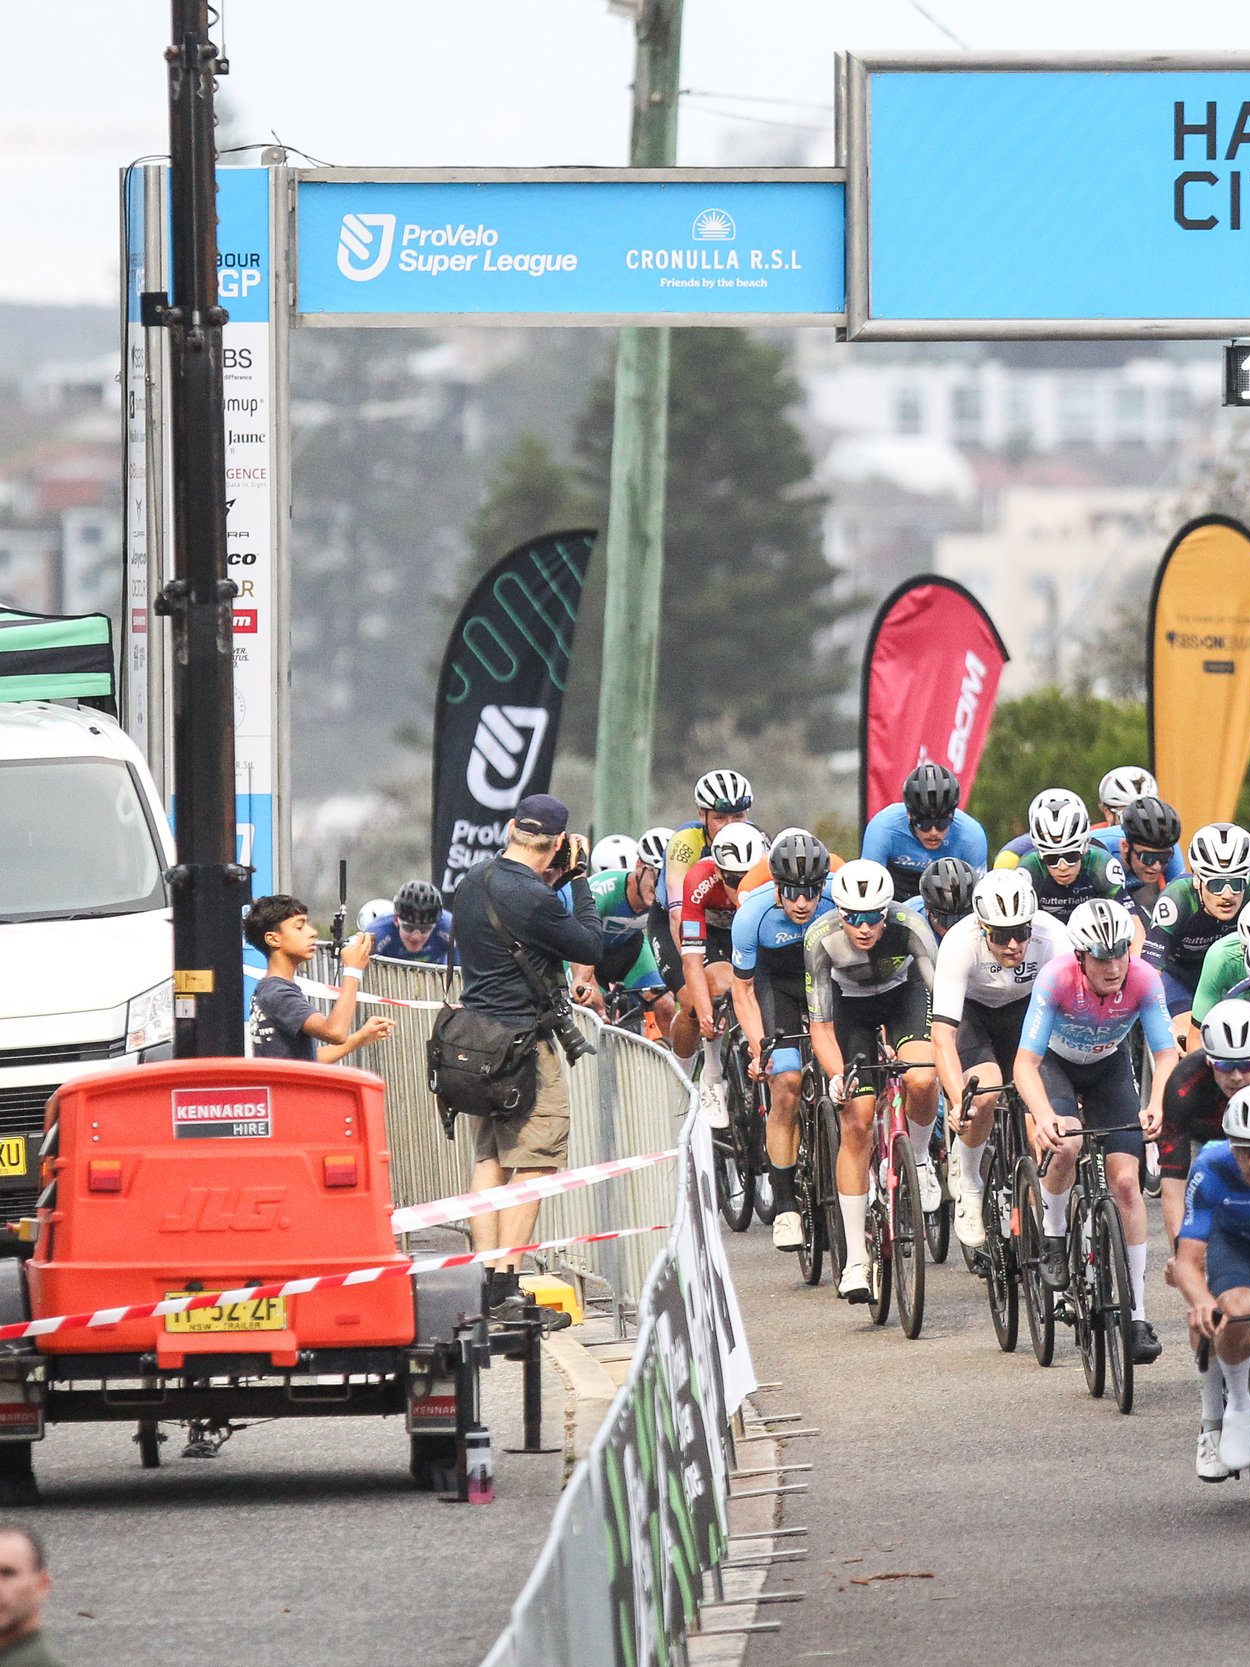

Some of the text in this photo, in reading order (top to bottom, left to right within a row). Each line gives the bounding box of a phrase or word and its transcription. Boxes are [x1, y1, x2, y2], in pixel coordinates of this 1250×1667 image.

[402, 224, 499, 247] ProVelo
[217, 253, 259, 267] BOUR
[398, 249, 578, 276] Super League
[626, 249, 802, 270] CRONULLA R.S.L
[219, 269, 261, 297] GP
[660, 277, 768, 290] Friends by the beach
[223, 349, 252, 368] BS
[228, 430, 266, 444] Jaune
[226, 468, 266, 479] GENCE
[1158, 902, 1170, 919] B
[177, 1103, 266, 1120] KENNARDS
[233, 1122, 267, 1136] HIRE
[188, 1323, 212, 1331] NSW
[223, 1321, 261, 1330] TRAILER
[413, 1405, 456, 1416] KENNAR
